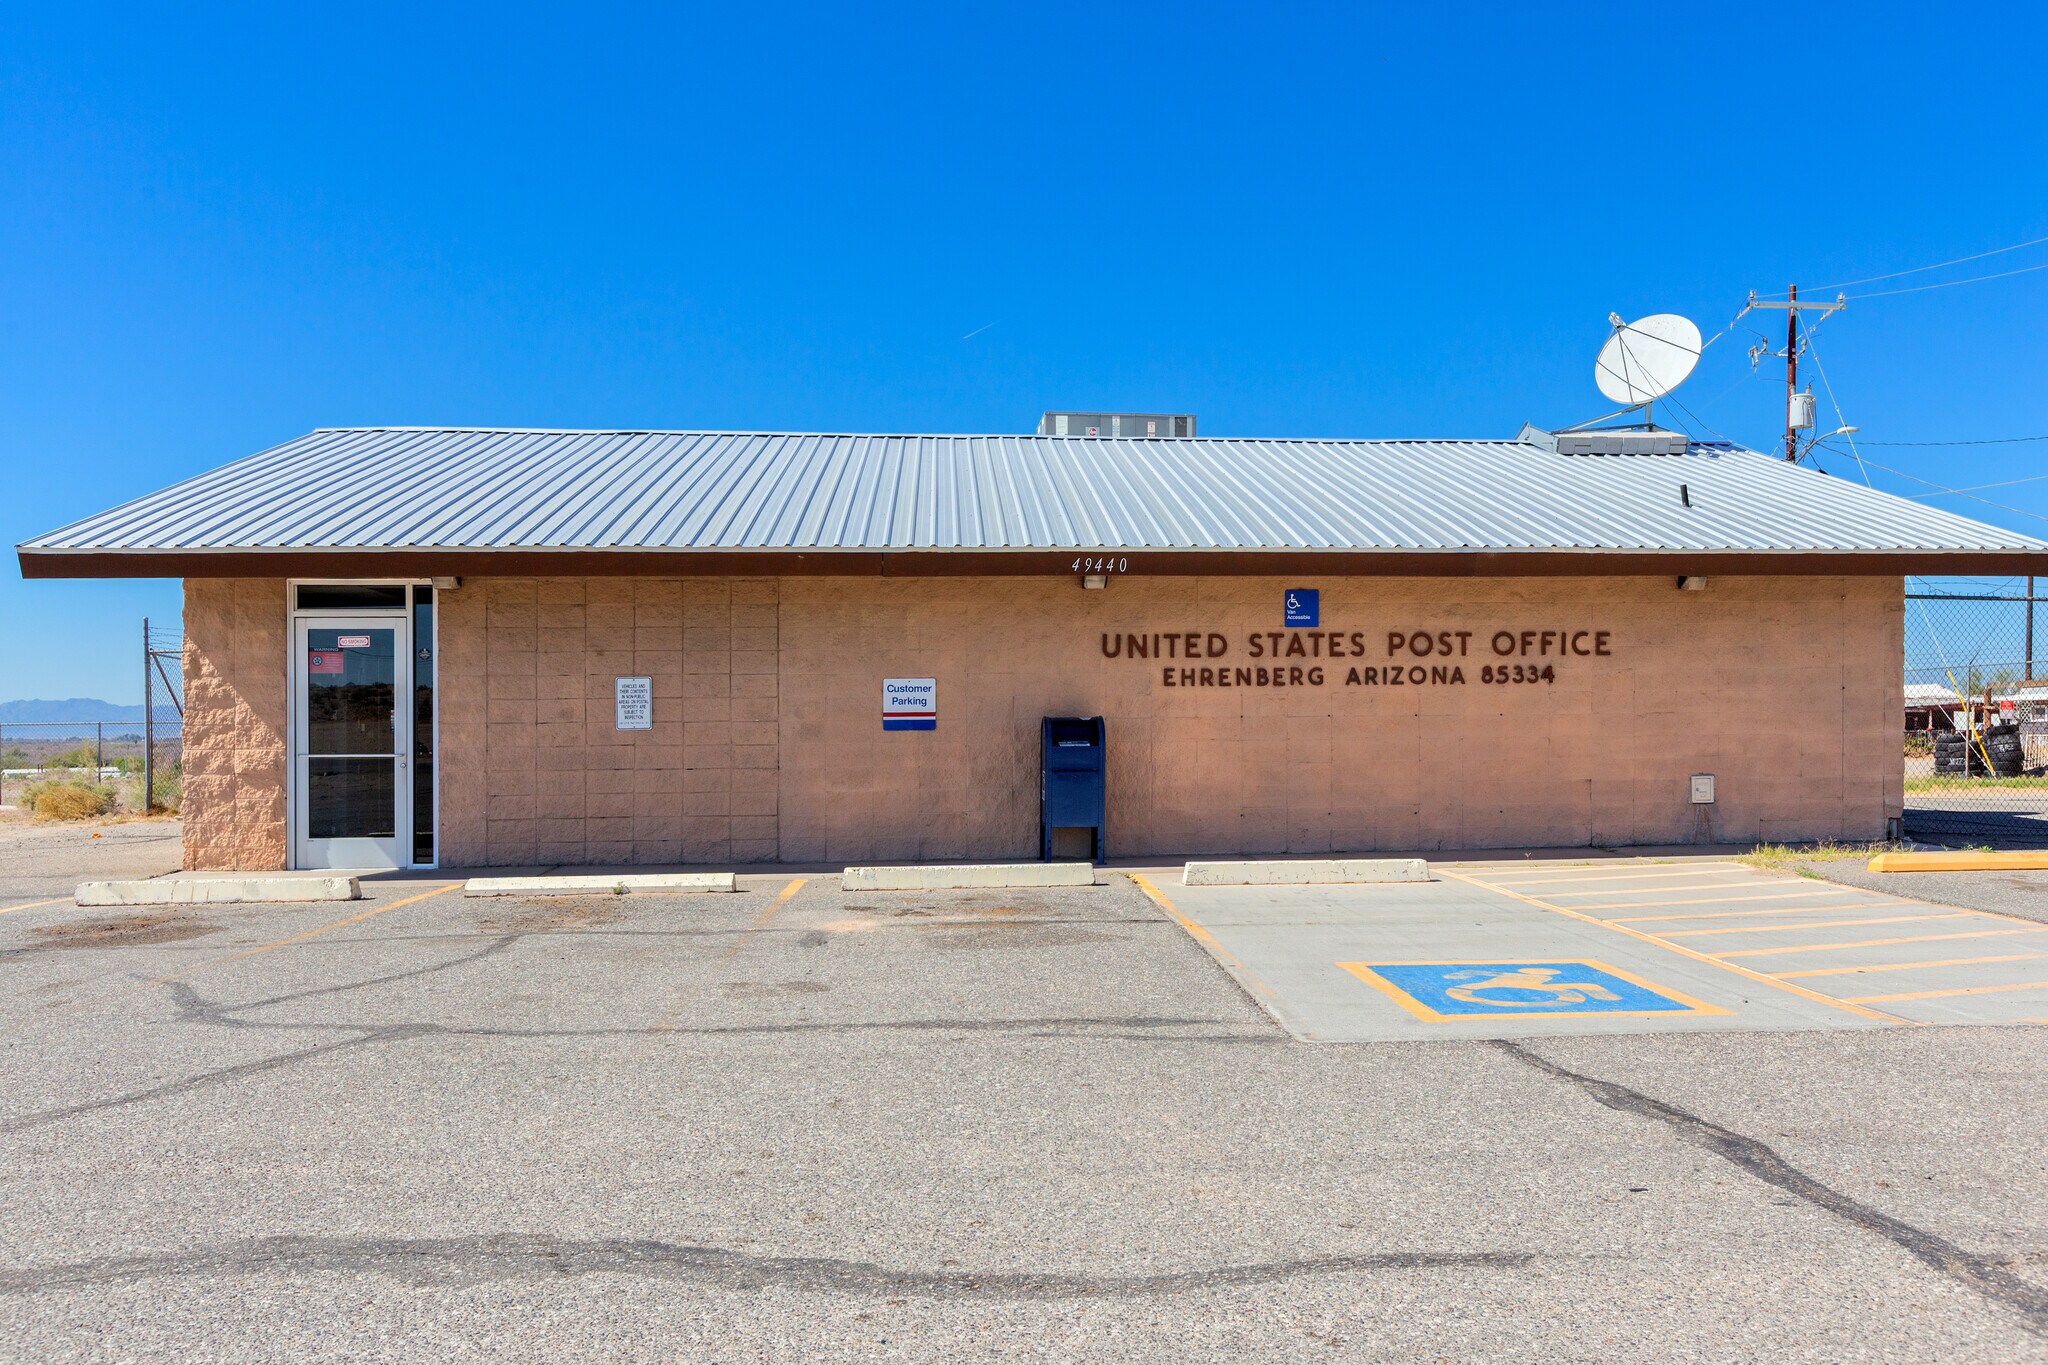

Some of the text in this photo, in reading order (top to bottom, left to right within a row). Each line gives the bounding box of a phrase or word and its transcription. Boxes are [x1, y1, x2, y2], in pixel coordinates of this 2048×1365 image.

[1071, 557, 1127, 573] 49440
[1101, 630, 1611, 659] UNITED STATES POST OFFICE
[1162, 664, 1556, 687] EHRENBERG ARIZONA 85334
[887, 684, 932, 693] Customer
[892, 697, 927, 707] Parking
